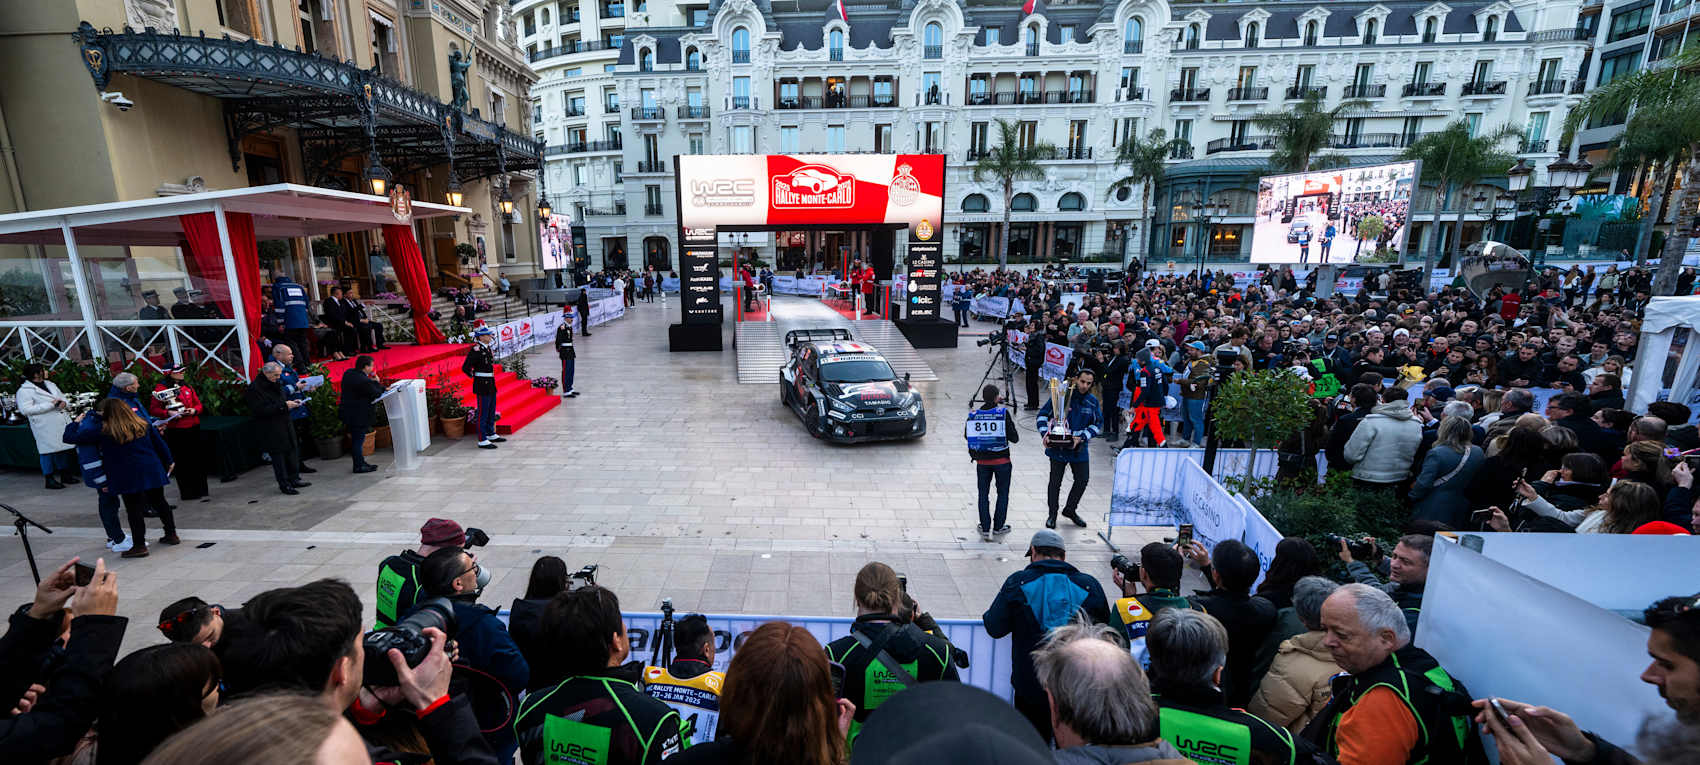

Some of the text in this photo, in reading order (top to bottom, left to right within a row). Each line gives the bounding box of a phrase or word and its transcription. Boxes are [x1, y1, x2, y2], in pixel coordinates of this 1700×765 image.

[691, 179, 755, 195] WRC
[775, 186, 800, 205] RALLYE
[801, 186, 852, 205] MONTE-CARLO
[685, 228, 715, 236] WRC
[975, 422, 997, 432] 810
[1199, 497, 1221, 527] CASINO
[653, 684, 673, 693] RALLYE
[672, 693, 684, 701] JAN
[684, 696, 701, 705] 2025
[551, 739, 597, 762] WRC
[1176, 735, 1239, 760] WRC
